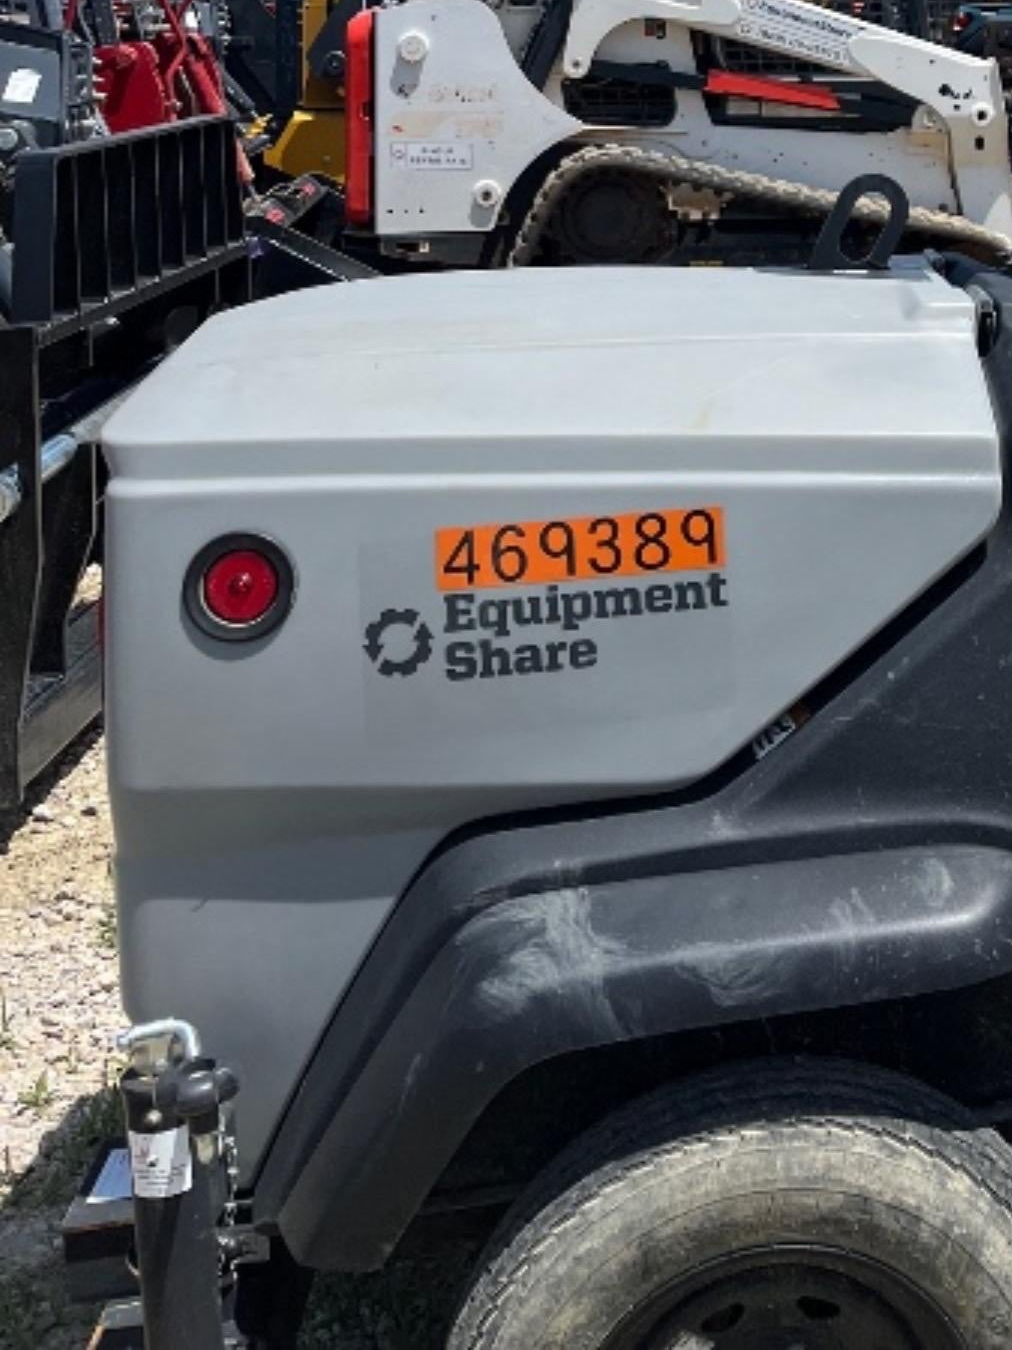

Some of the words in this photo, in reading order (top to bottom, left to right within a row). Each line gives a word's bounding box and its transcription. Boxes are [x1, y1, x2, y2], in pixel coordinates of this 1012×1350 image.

[443, 508, 719, 585] 469389
[443, 572, 729, 637] Equipment
[445, 636, 598, 681] Share
